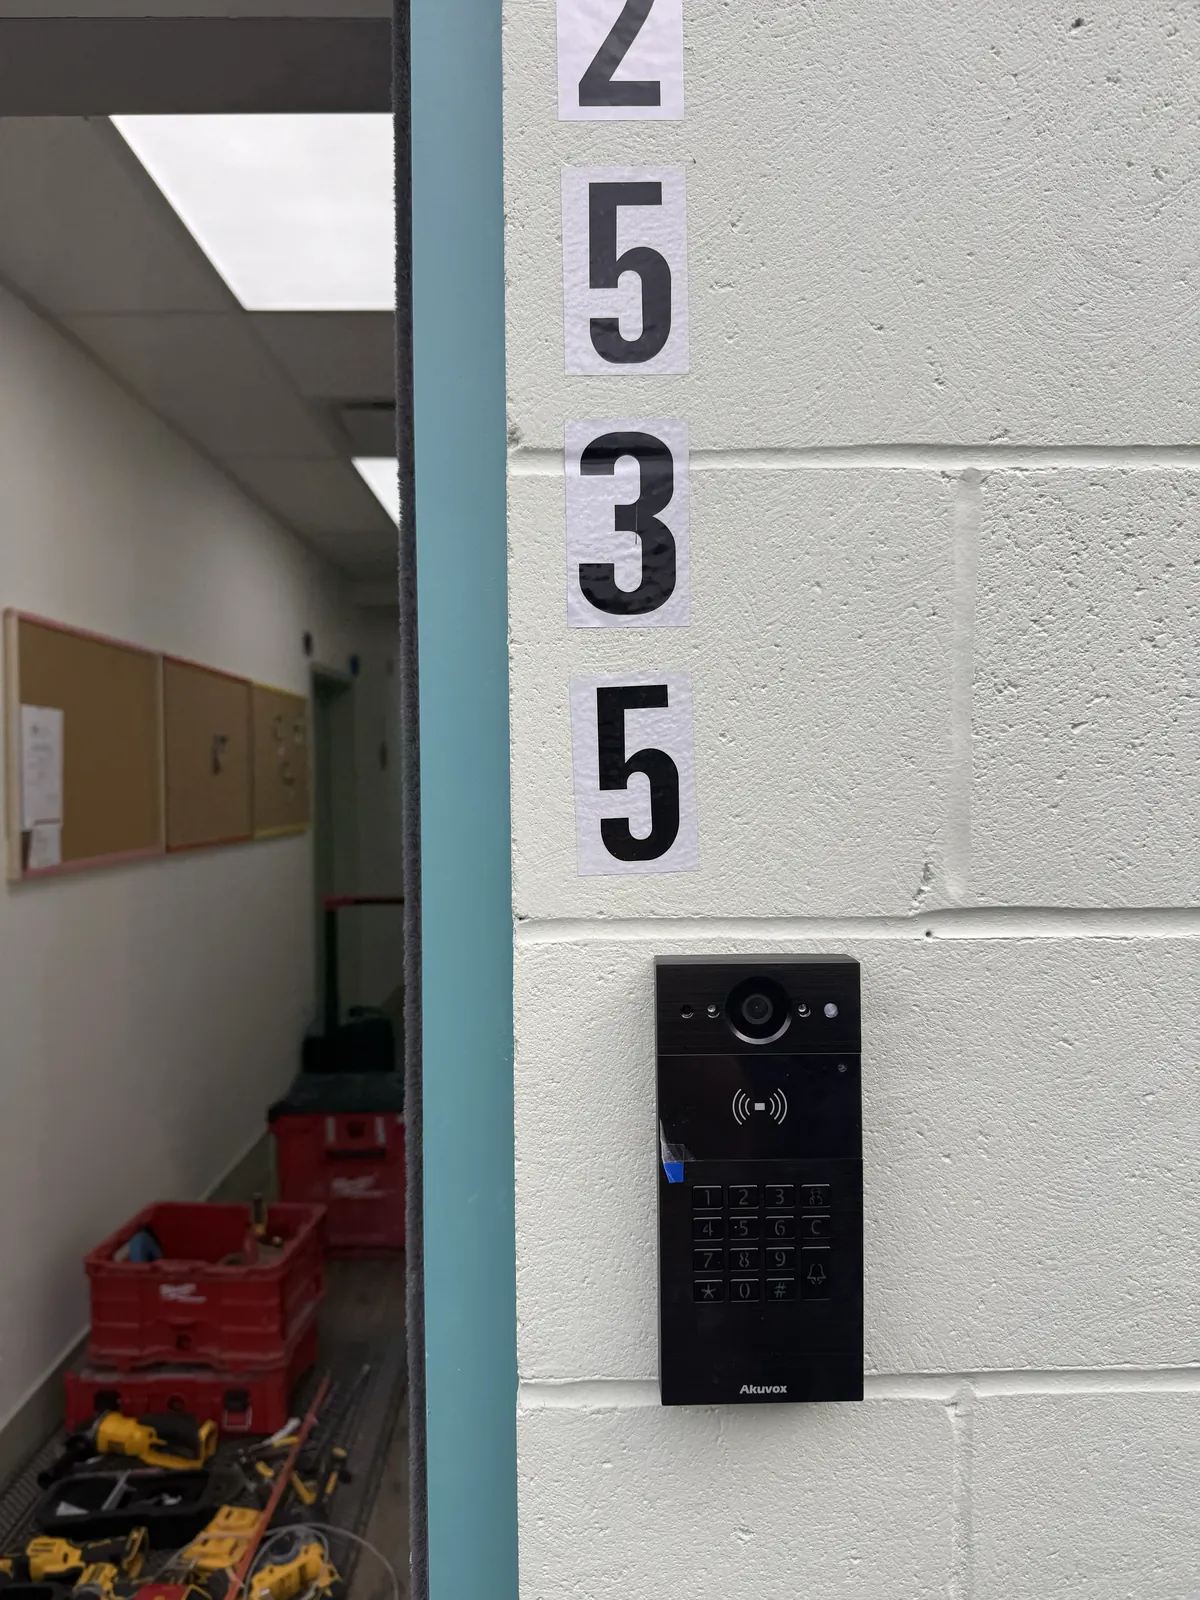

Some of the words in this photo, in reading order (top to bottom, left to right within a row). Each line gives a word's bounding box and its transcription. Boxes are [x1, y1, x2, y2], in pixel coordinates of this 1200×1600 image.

[738, 1189, 749, 1205] 2
[775, 1188, 784, 1205] 3
[702, 1221, 714, 1236] 4
[739, 1220, 748, 1236] 5
[774, 1219, 785, 1236] 6
[811, 1219, 822, 1235] C
[703, 1252, 713, 1268] 7
[739, 1251, 750, 1268] 8
[775, 1251, 786, 1267] 9
[739, 1283, 750, 1299] 0
[739, 1384, 788, 1395] Akuvox
